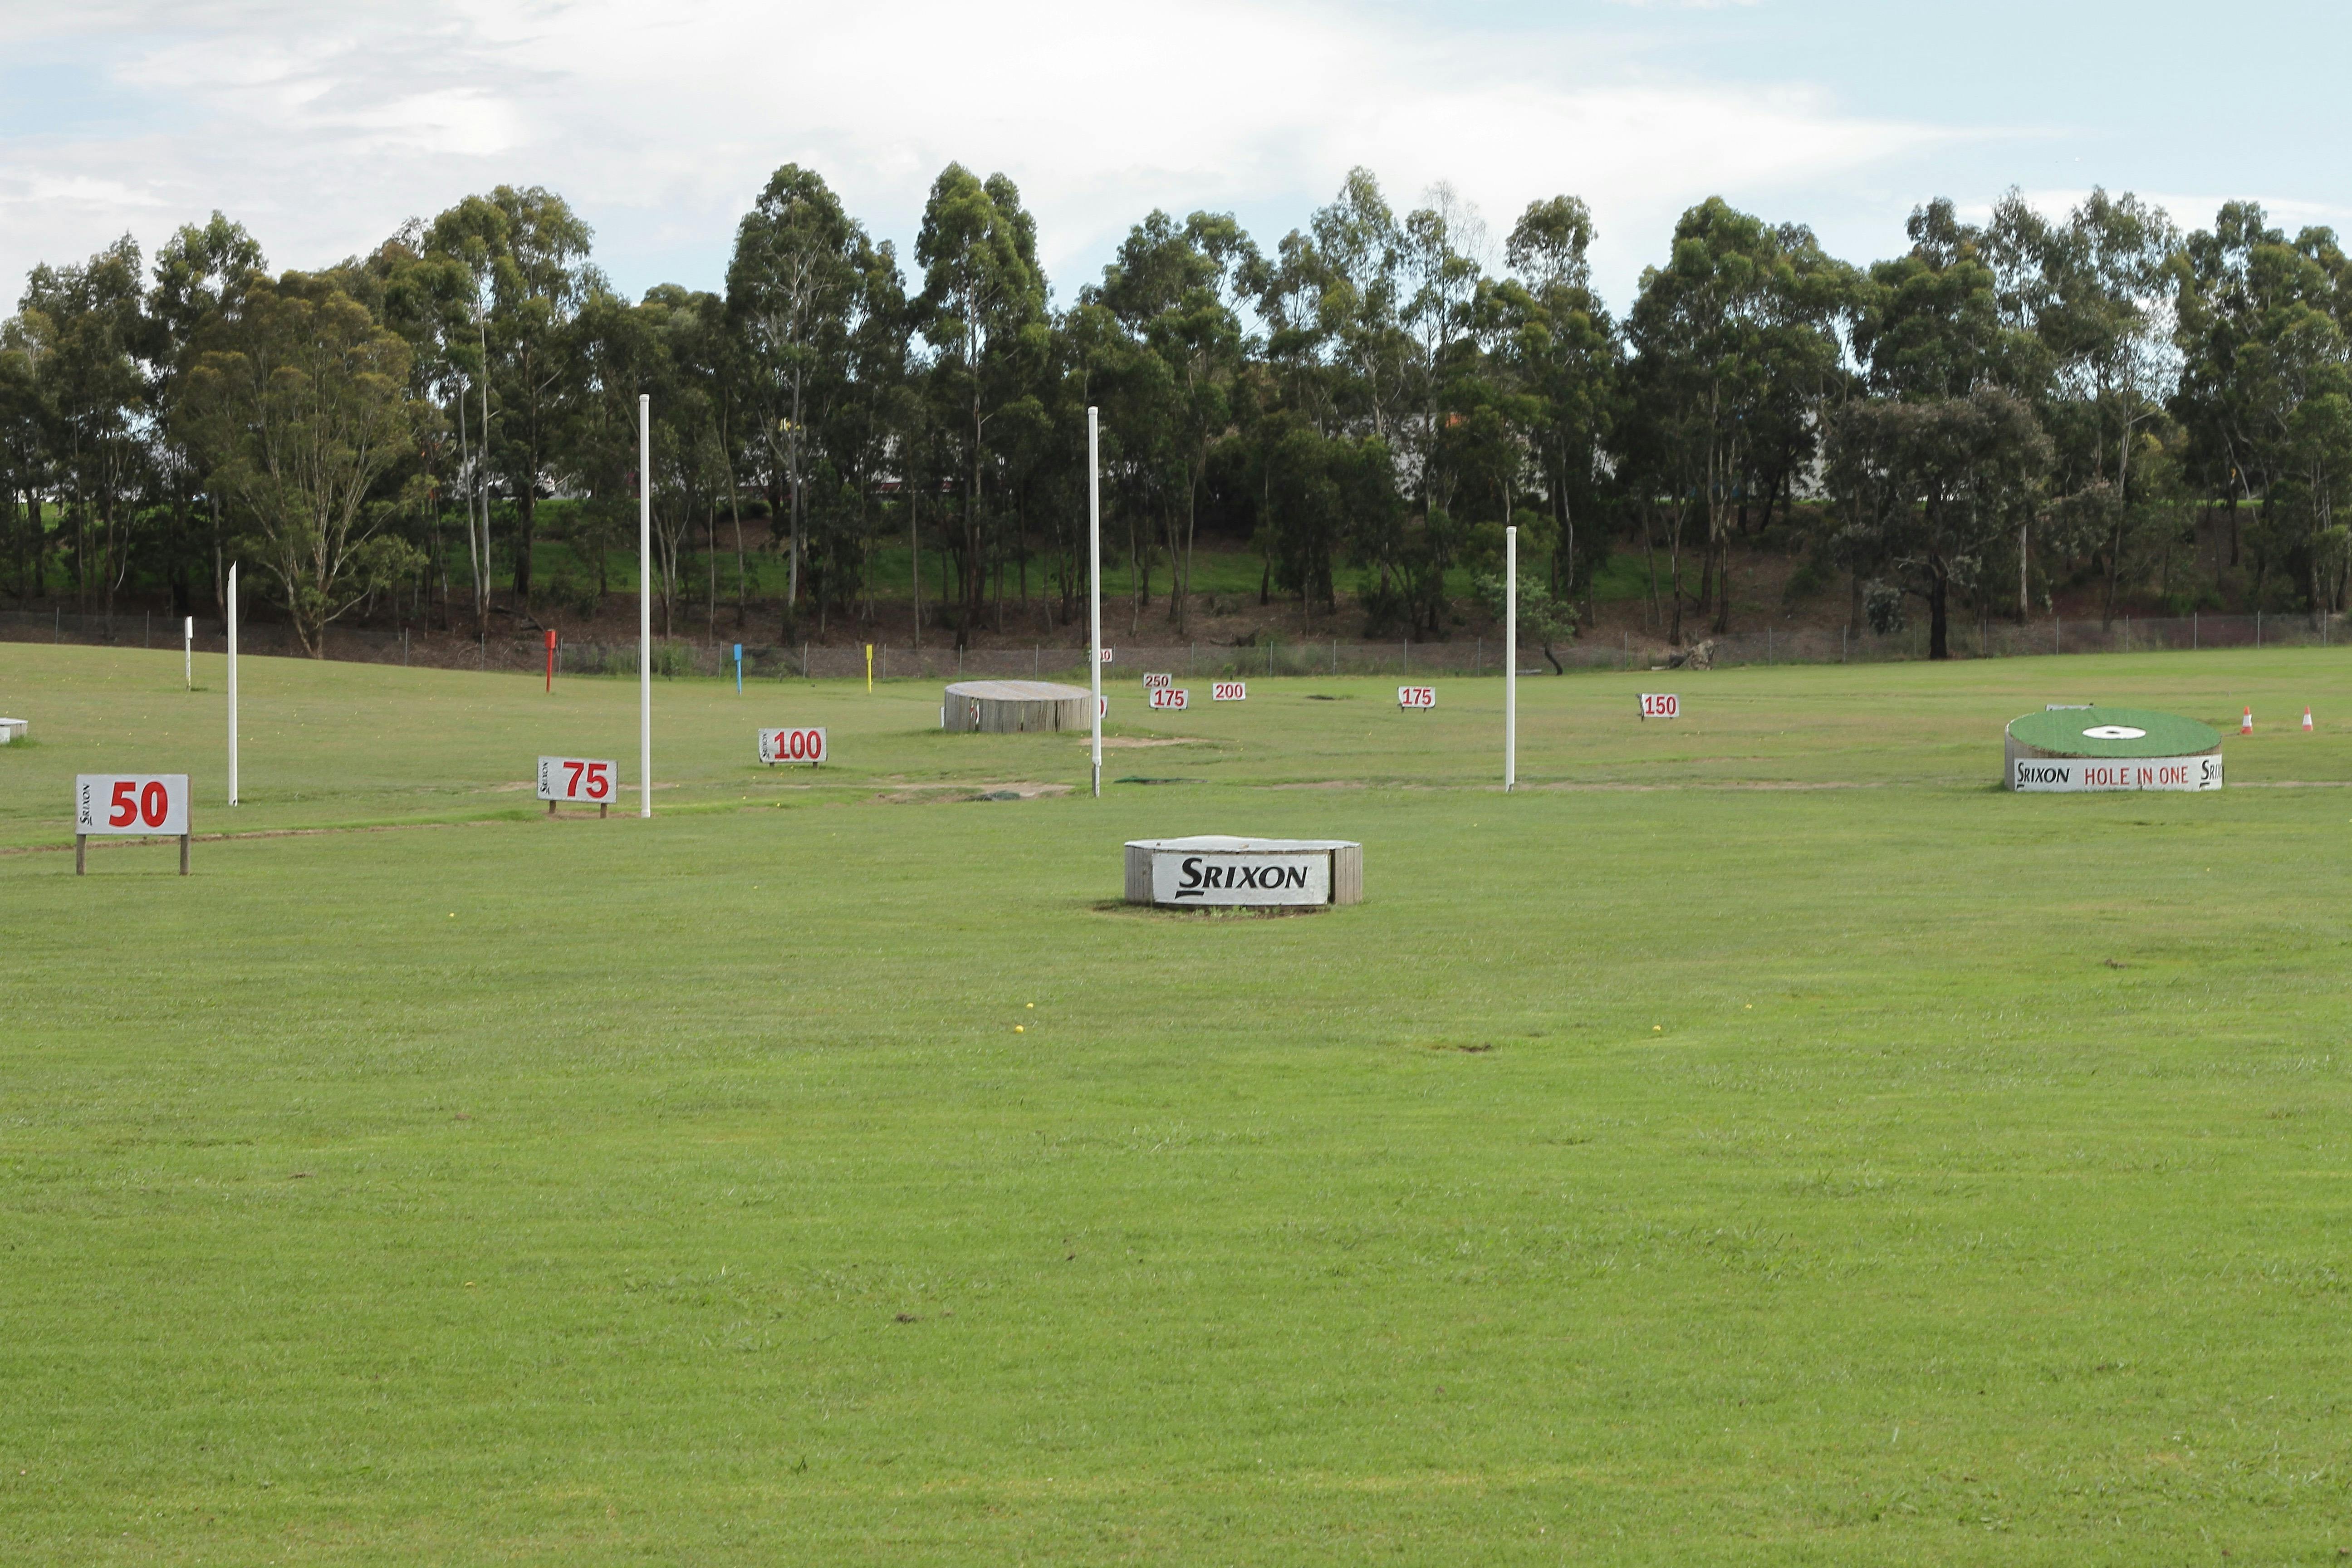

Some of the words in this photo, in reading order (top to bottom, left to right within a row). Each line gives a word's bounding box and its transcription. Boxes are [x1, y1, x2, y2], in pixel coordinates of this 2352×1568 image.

[1145, 676, 1169, 687] 250
[1216, 684, 1243, 698] 200
[1155, 690, 1184, 706] 175
[1403, 689, 1431, 705] 175
[1645, 696, 1676, 715] 150
[774, 730, 822, 759] 100
[563, 762, 609, 798] 75
[2016, 762, 2071, 790] SRIXON
[2085, 767, 2130, 785] HOLE
[2137, 767, 2152, 784] IN
[2160, 766, 2188, 784] ONE
[80, 782, 93, 827] SRIXON
[108, 781, 168, 827] 50
[1174, 857, 1308, 900] SRIXON
